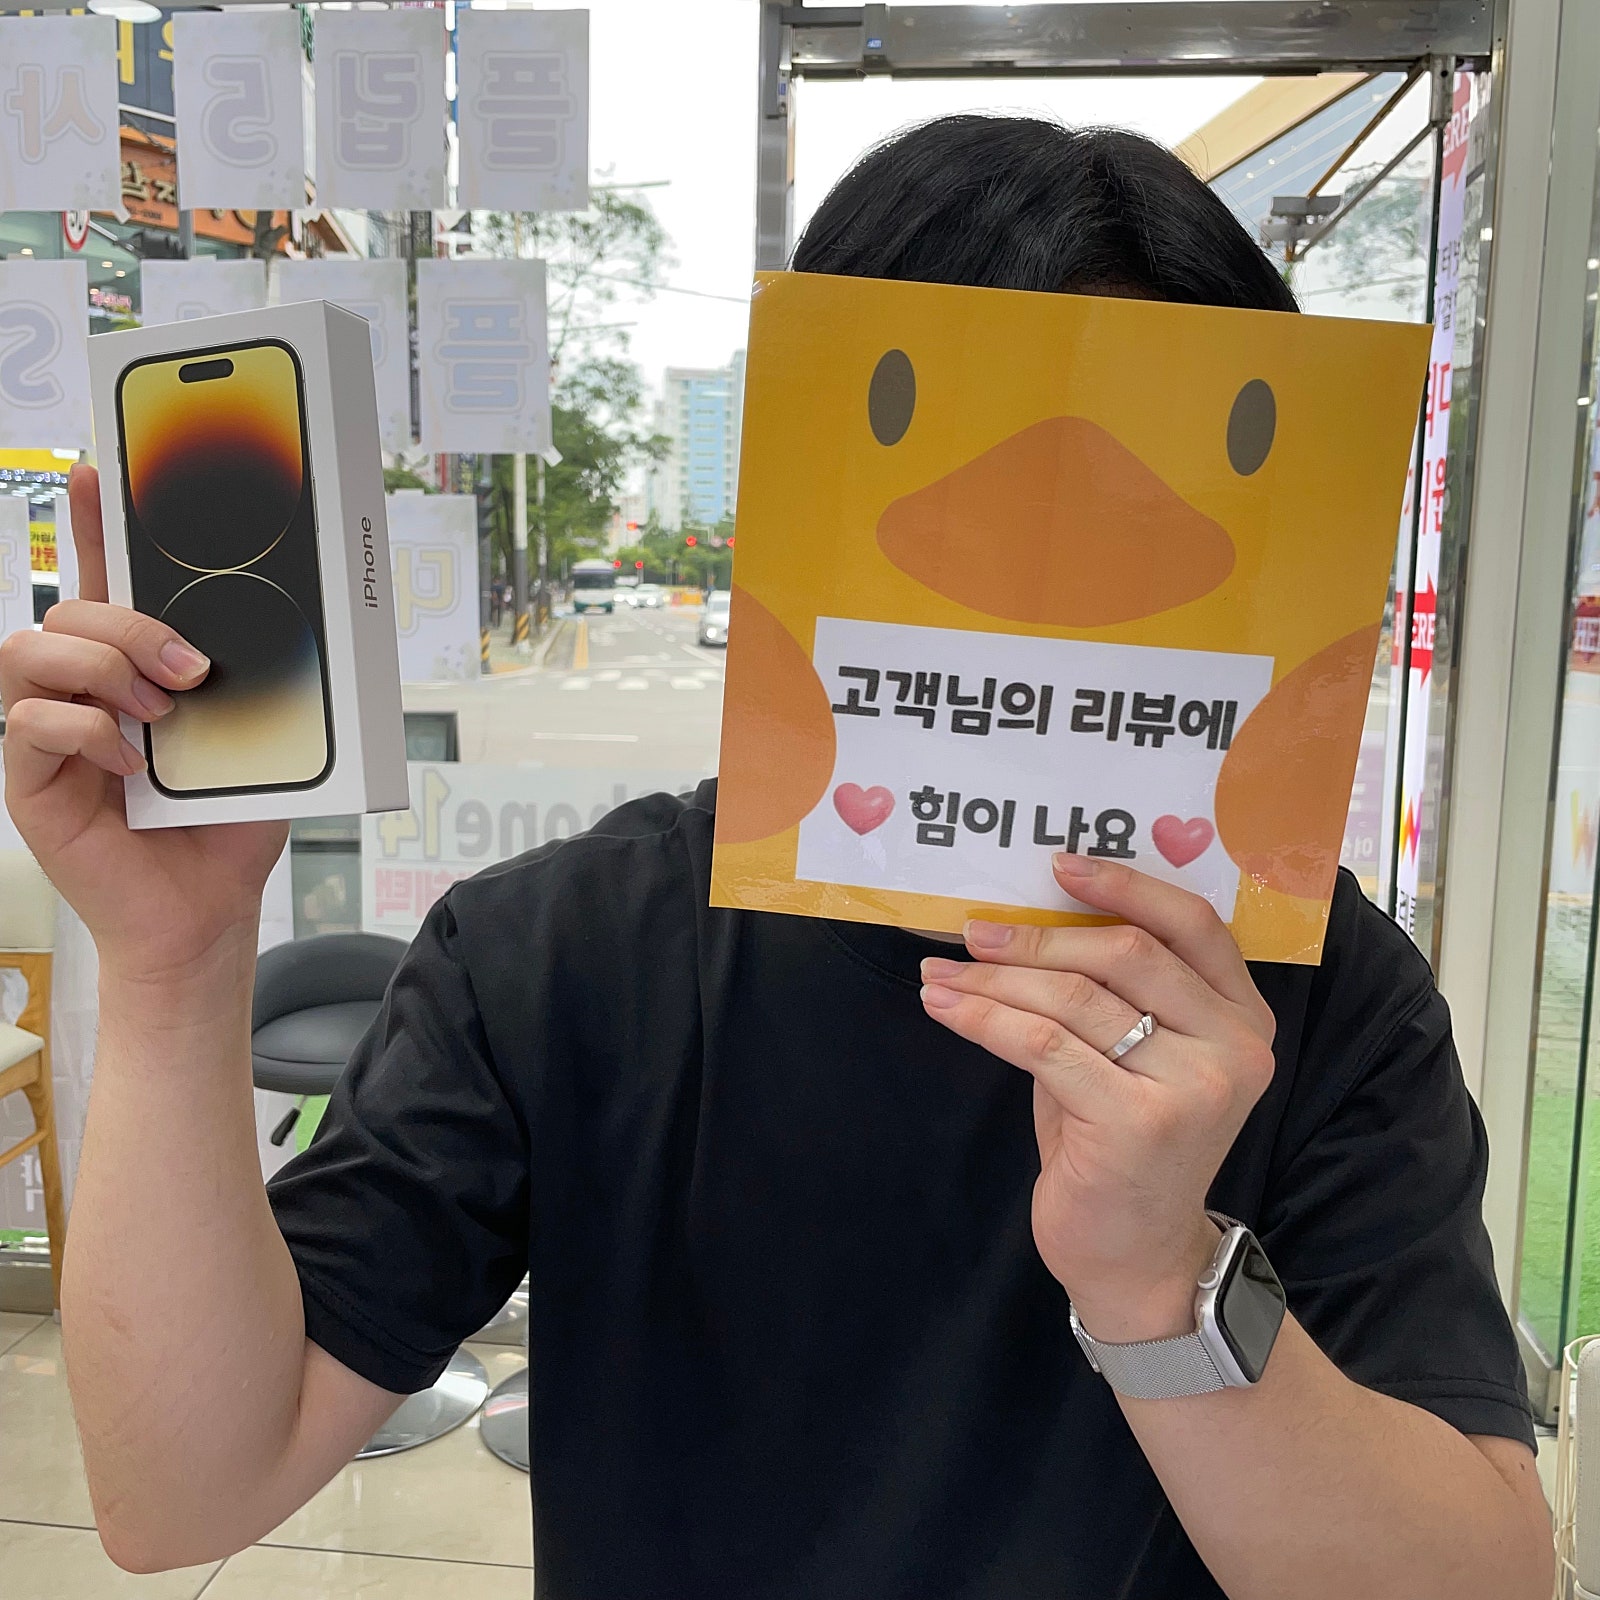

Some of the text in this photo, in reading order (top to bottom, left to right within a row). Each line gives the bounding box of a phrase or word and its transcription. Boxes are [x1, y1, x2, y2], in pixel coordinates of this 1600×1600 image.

[1442, 103, 1469, 159] ERE
[361, 516, 378, 608] iPhone
[831, 665, 1238, 751] 고객님의 리뷰에
[908, 785, 1137, 859] 힘이 나요
